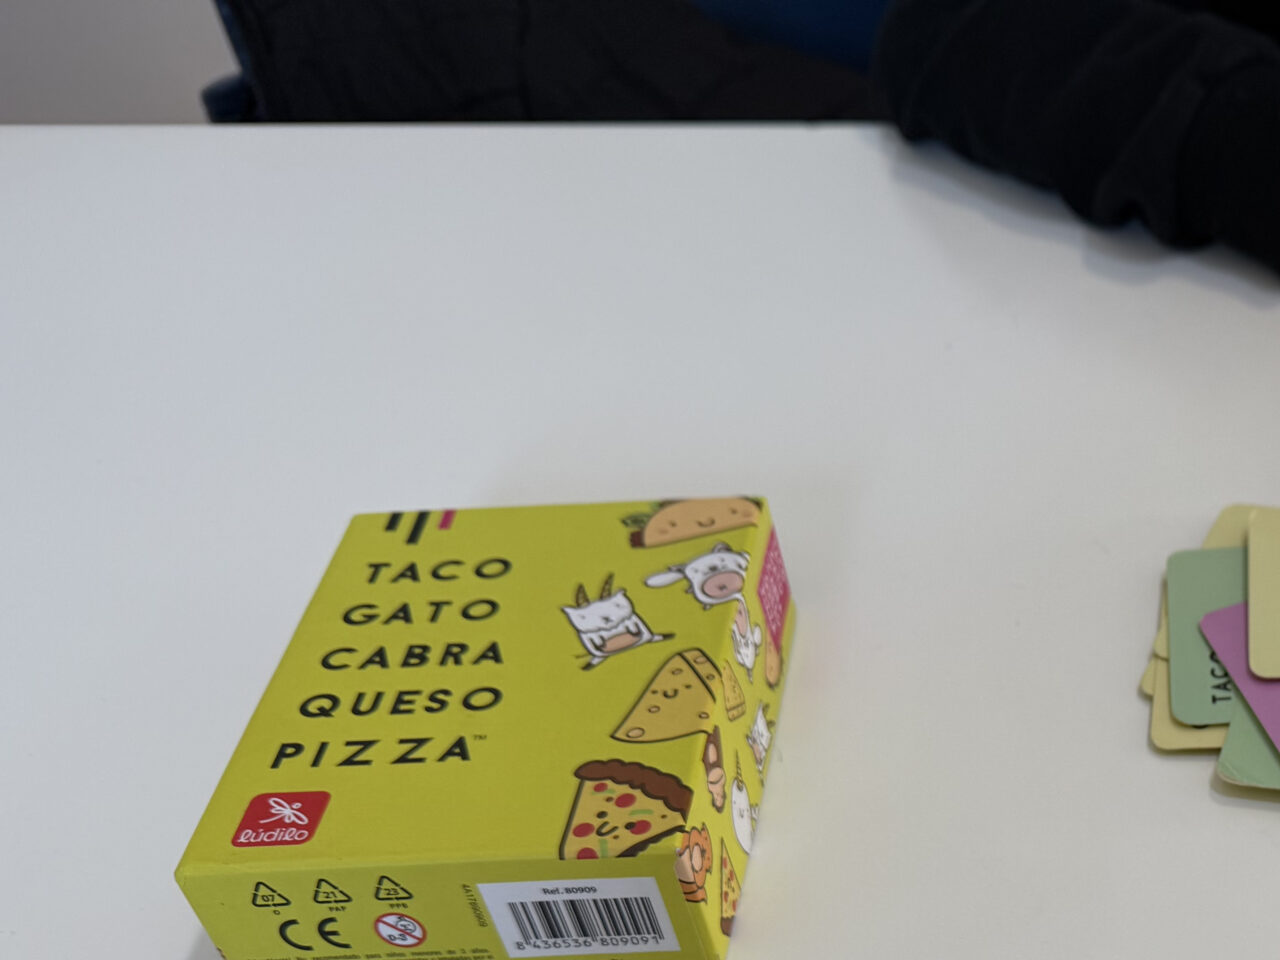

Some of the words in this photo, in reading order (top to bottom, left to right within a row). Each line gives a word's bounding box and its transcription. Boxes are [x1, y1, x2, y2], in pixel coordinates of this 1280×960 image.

[367, 557, 513, 585] TACO
[342, 598, 501, 626] GATO
[320, 641, 504, 671] CABRA
[299, 686, 504, 719] QUESO
